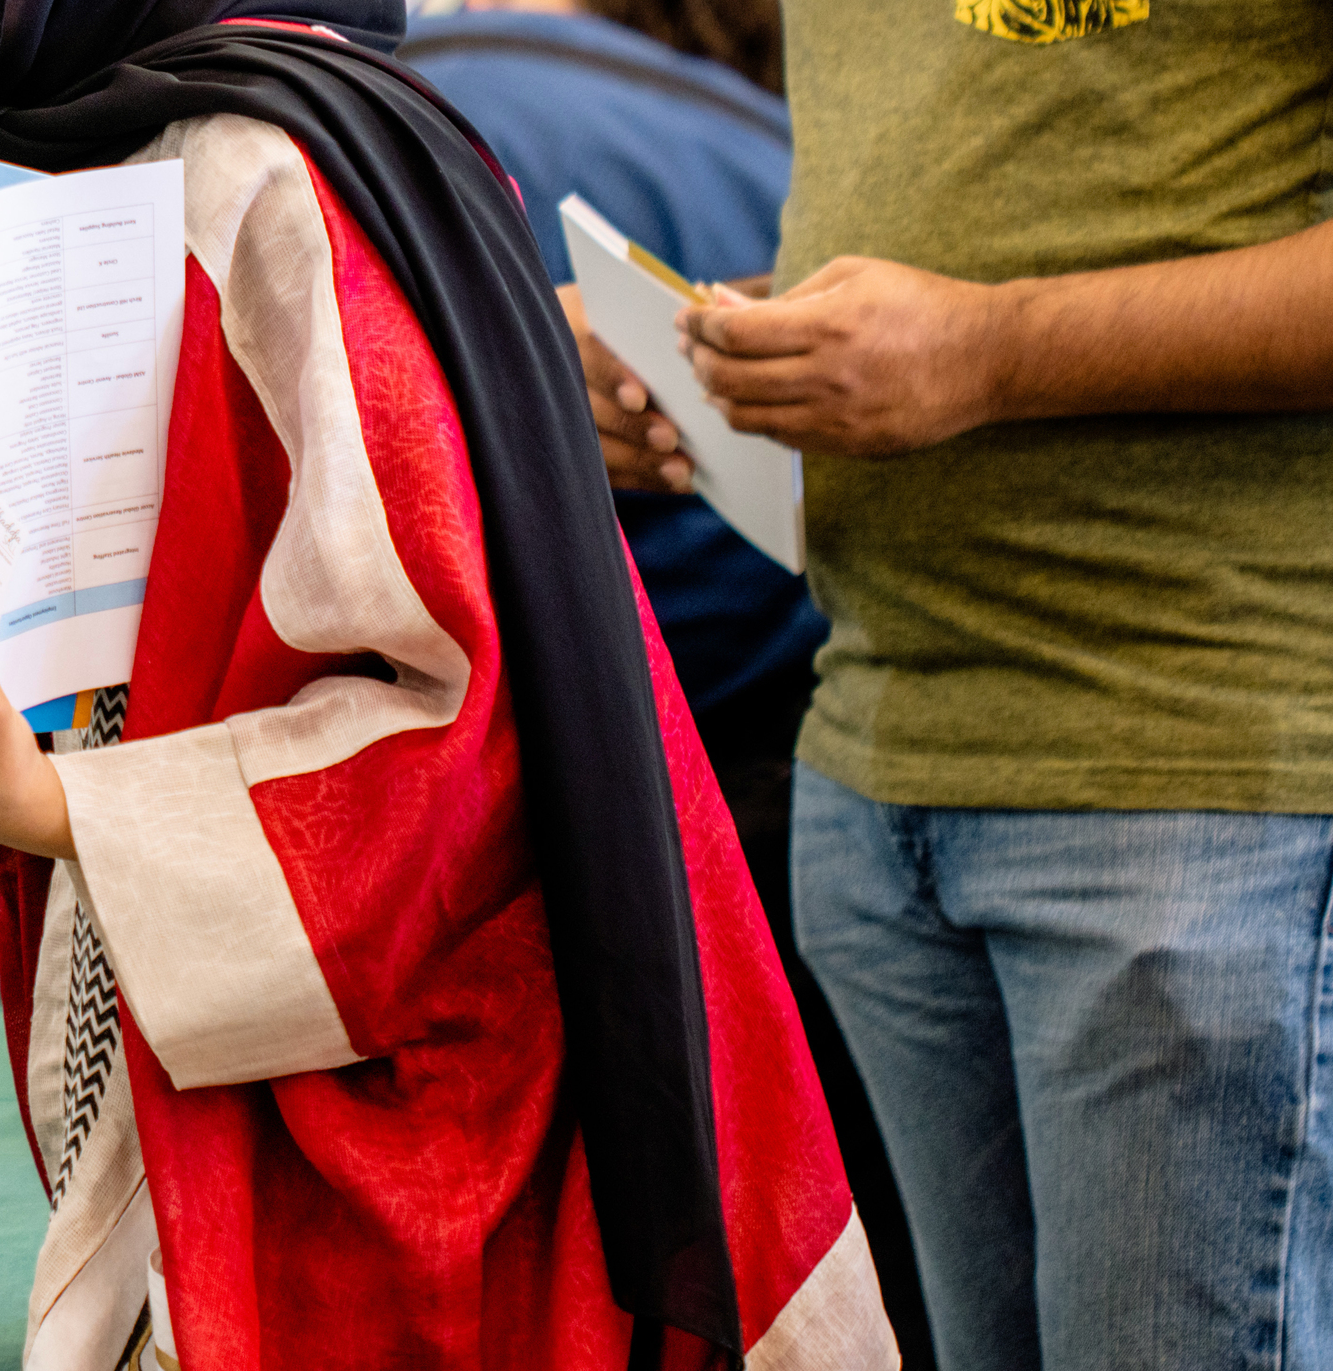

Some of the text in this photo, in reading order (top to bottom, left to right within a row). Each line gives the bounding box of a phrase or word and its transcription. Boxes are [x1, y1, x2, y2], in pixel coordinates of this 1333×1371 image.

[101, 220, 122, 228] Building
[85, 299, 118, 309] Construction
[121, 448, 143, 456] Medavie
[93, 509, 122, 518] Reservation
[112, 547, 138, 555] Integrated
